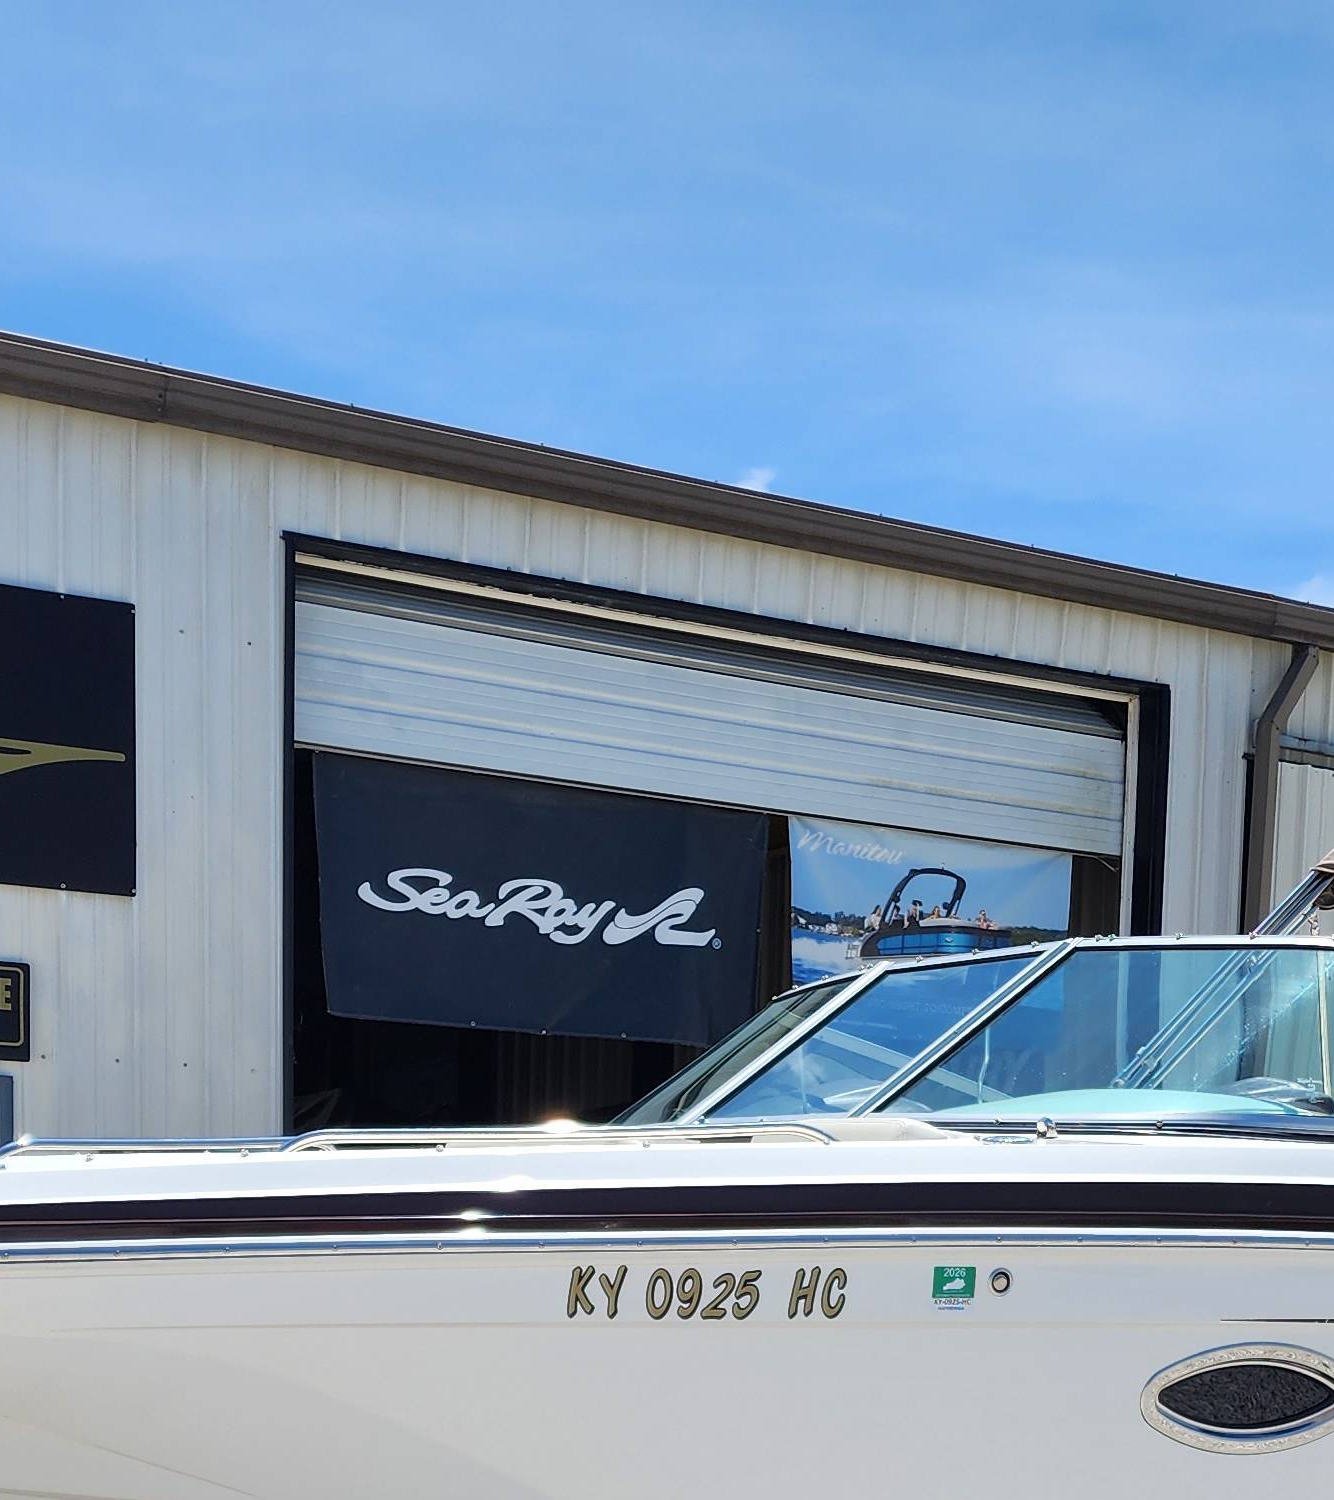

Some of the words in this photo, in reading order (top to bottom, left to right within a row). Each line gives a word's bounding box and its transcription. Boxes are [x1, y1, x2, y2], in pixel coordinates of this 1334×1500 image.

[796, 829, 906, 865] Manitou
[357, 867, 496, 919] Sea
[483, 878, 617, 945] Ray
[566, 1264, 628, 1319] KY
[645, 1267, 763, 1320] 0925
[787, 1265, 848, 1320] HC
[943, 1267, 967, 1278] 2026
